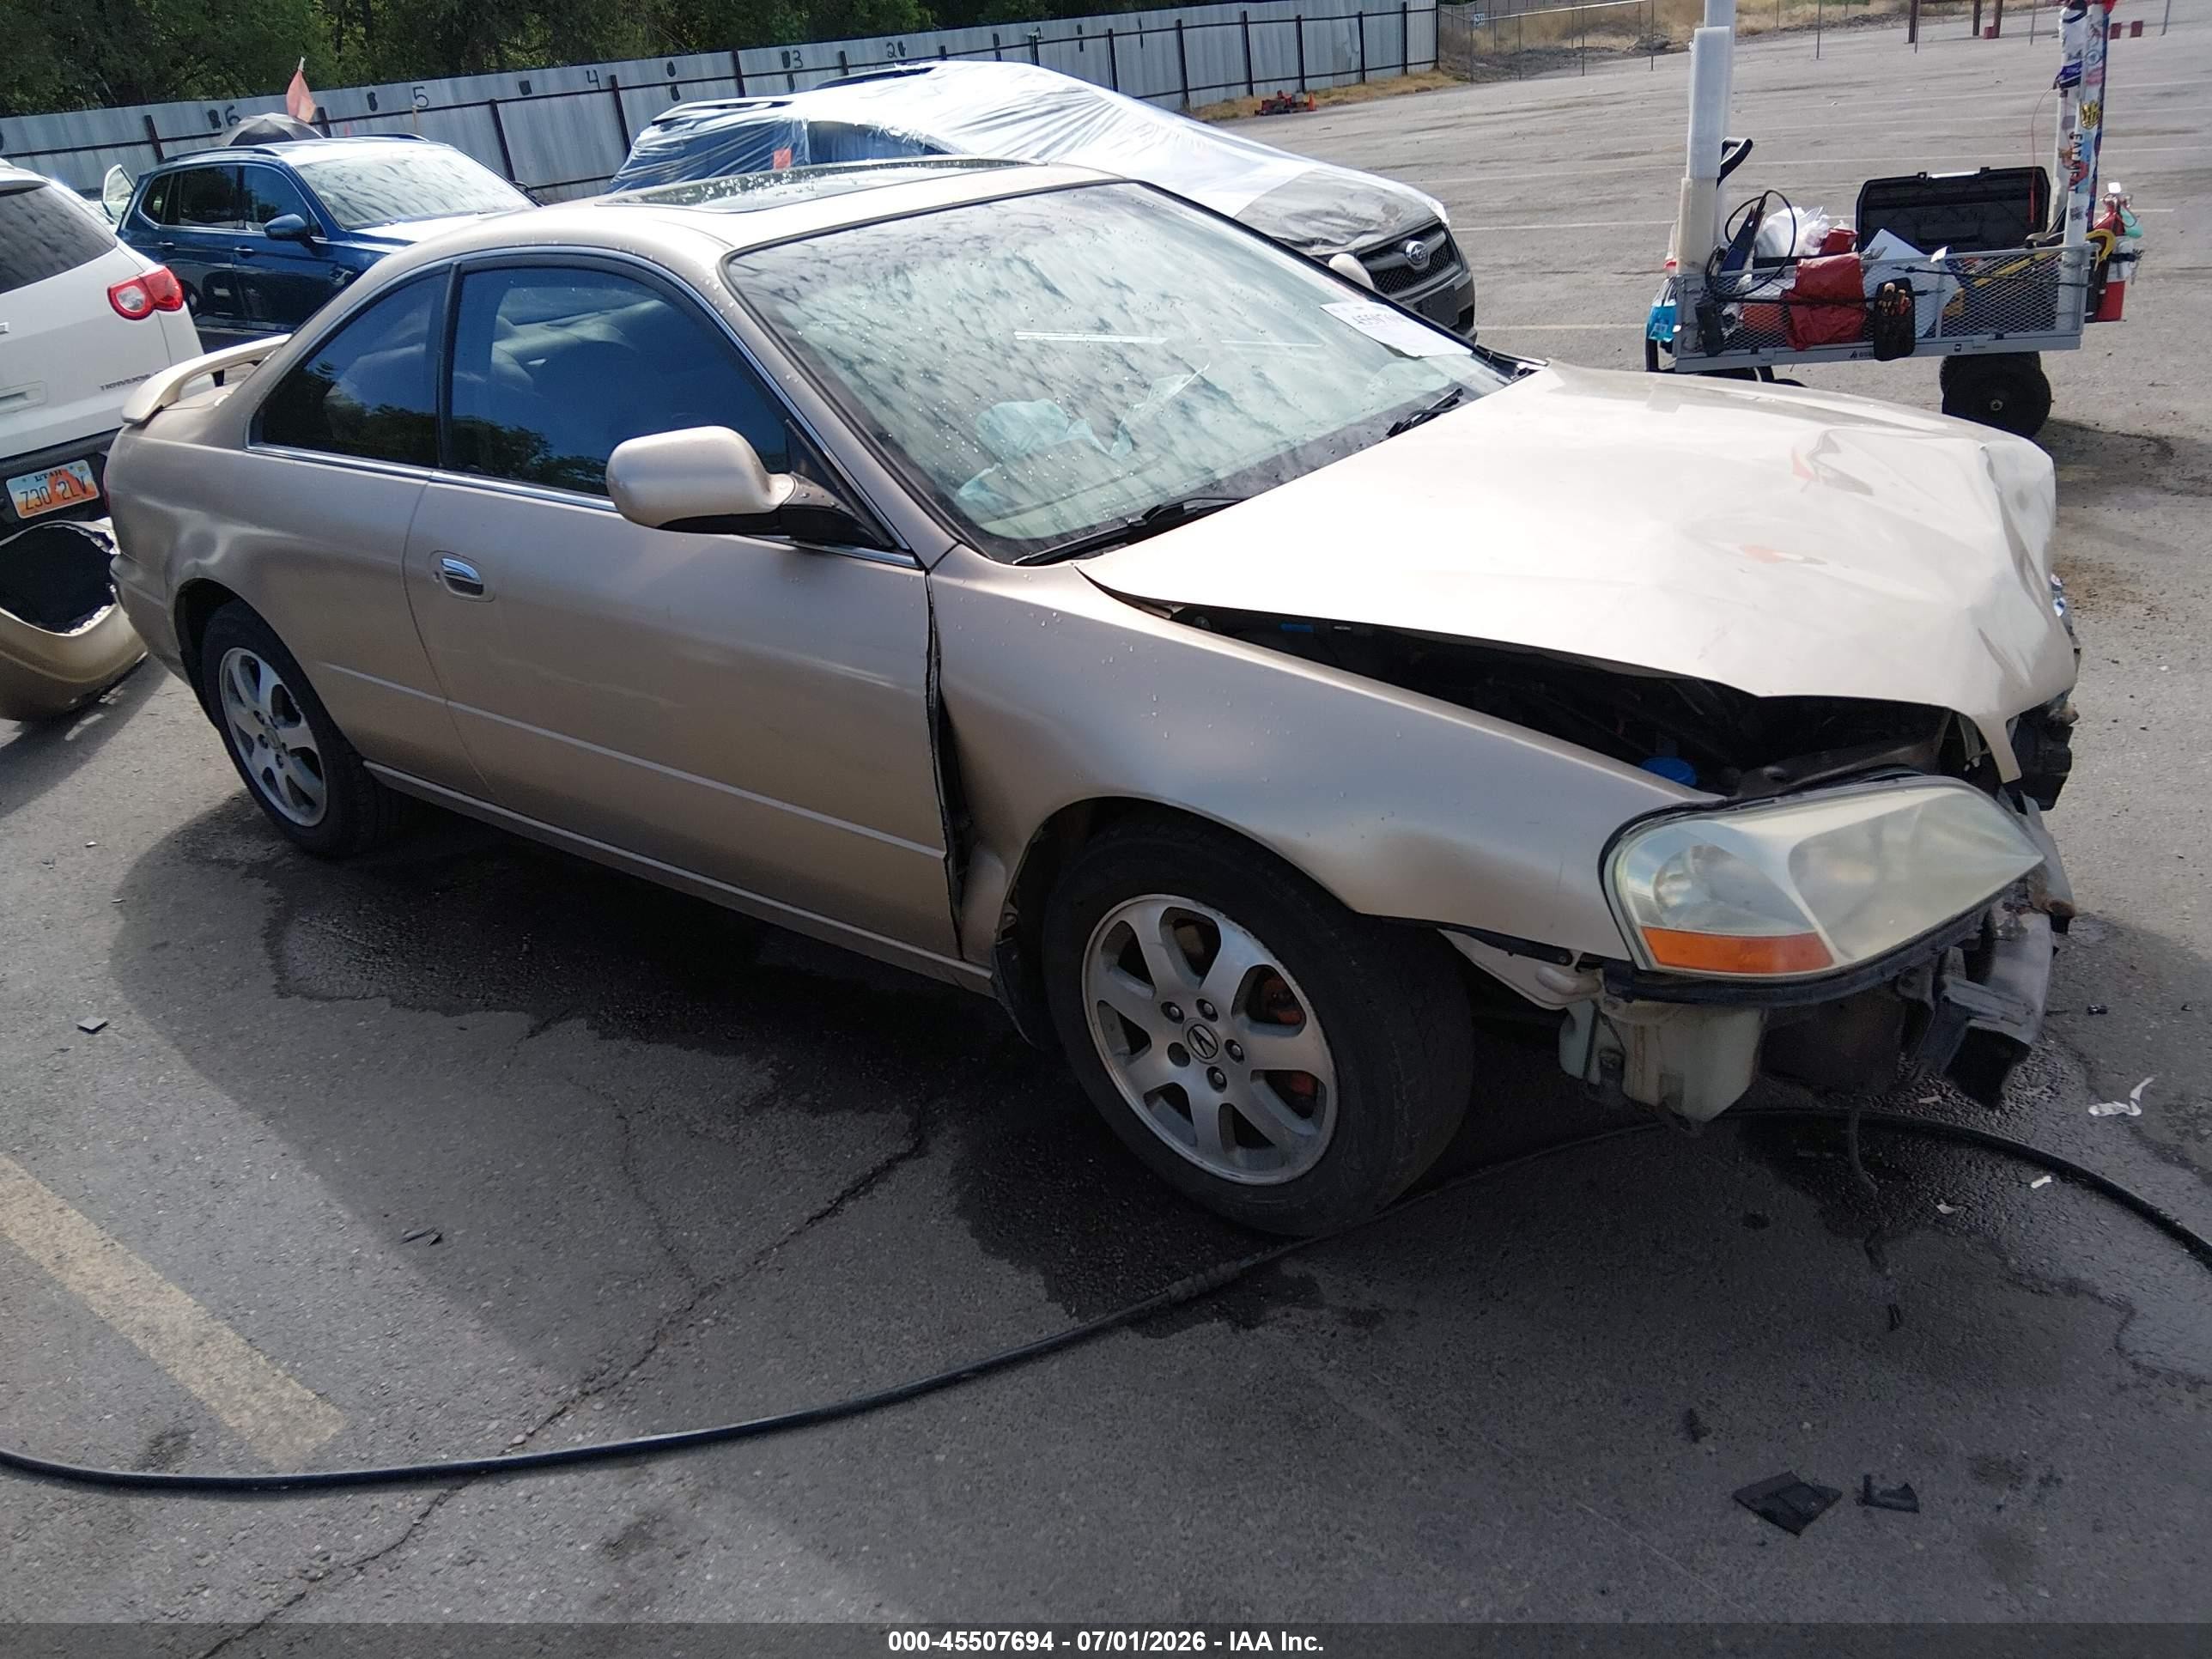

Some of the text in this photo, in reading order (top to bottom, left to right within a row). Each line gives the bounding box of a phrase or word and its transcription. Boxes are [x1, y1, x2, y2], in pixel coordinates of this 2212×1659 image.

[885, 41, 897, 58] 2
[793, 50, 803, 69] 3
[586, 70, 600, 89] 4
[412, 86, 428, 107] 5
[225, 104, 240, 126] 6
[34, 469, 63, 482] UTAH
[20, 475, 87, 510] Z30 2LV
